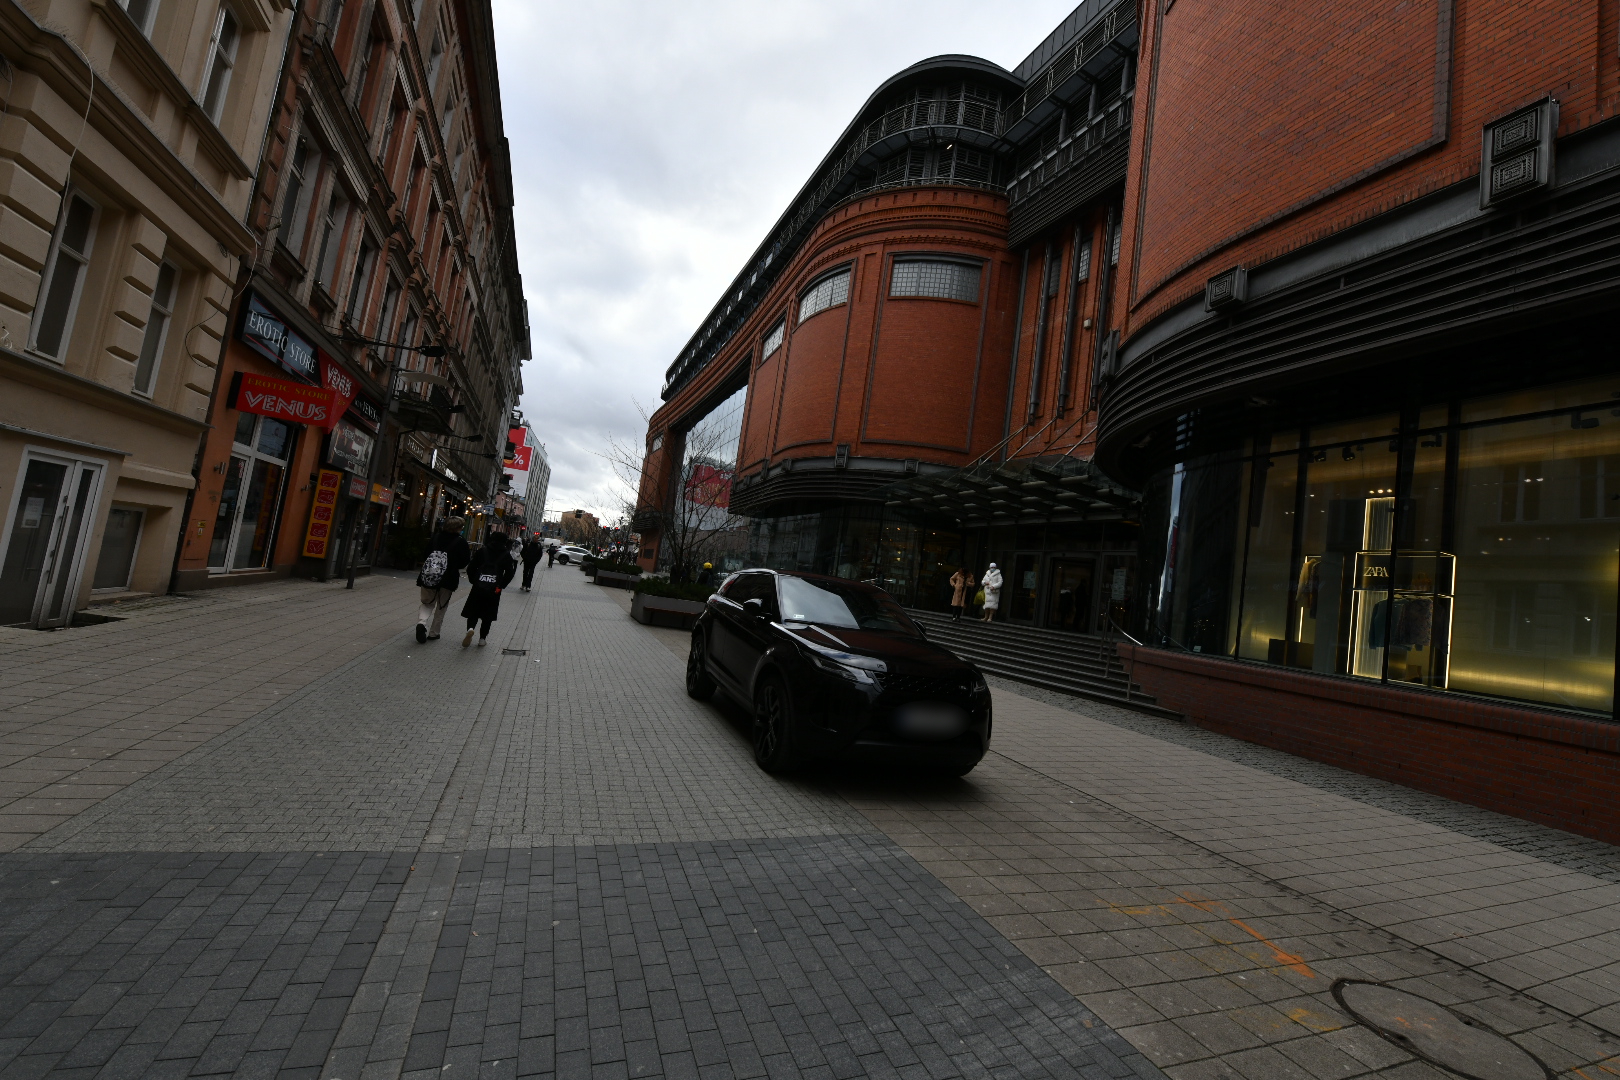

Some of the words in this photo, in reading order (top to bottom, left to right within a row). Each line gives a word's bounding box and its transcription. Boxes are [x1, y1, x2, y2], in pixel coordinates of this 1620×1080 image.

[248, 309, 289, 352] EROTIC
[289, 342, 317, 374] STORE
[247, 377, 290, 392] EROTIC
[295, 387, 330, 400] STORE
[244, 390, 327, 421] VENUS
[479, 573, 497, 583] VANS
[1363, 566, 1390, 577] ZARA
